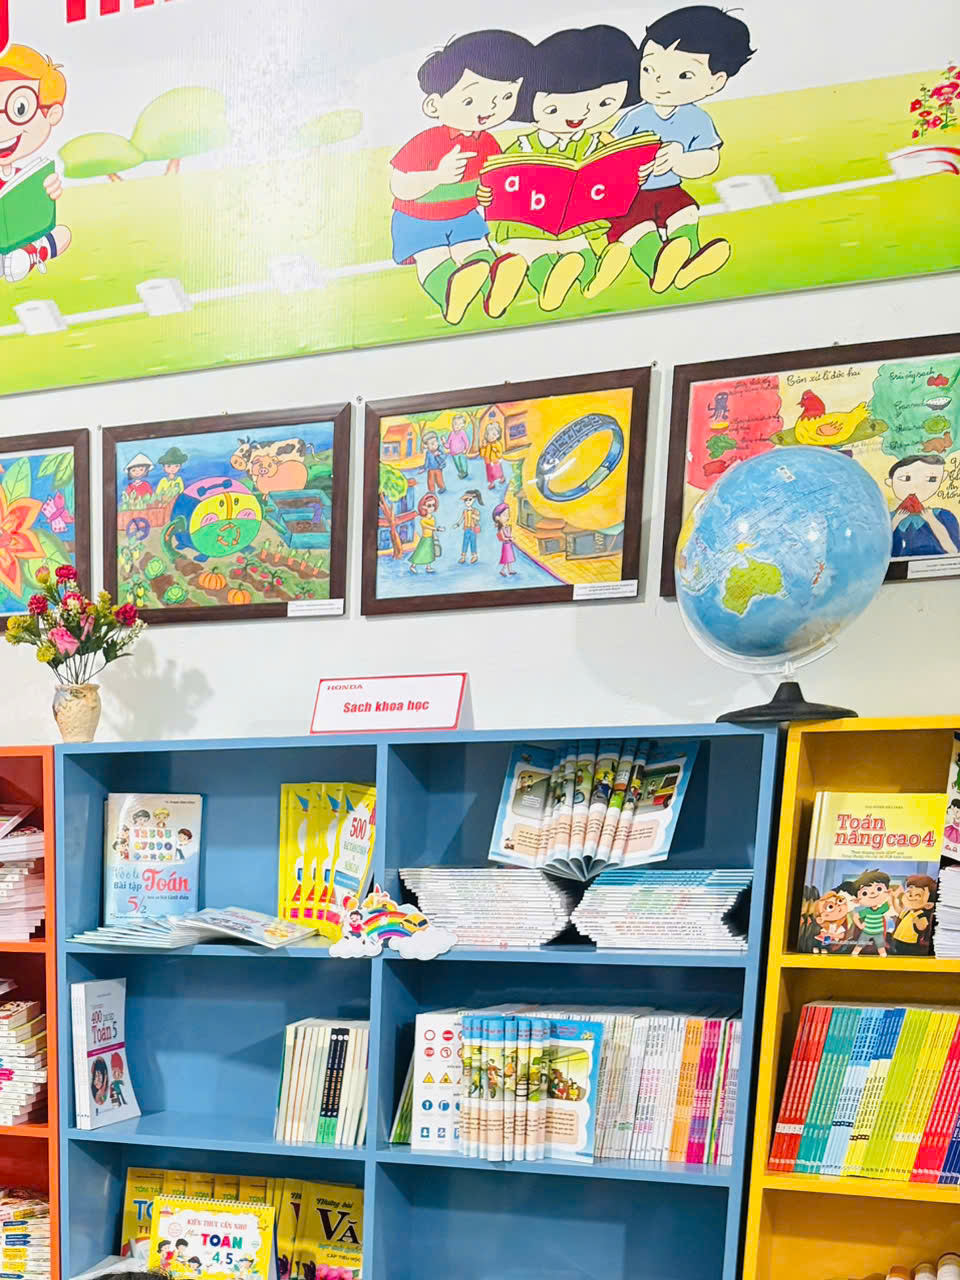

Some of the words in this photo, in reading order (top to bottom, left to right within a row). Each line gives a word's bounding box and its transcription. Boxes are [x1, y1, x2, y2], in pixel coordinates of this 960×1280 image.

[504, 173, 521, 192] a
[530, 190, 546, 211] b
[590, 183, 605, 202] c
[375, 700, 404, 712] khoa
[350, 817, 367, 840] 500
[921, 830, 936, 848] 4
[142, 868, 192, 892] Toán
